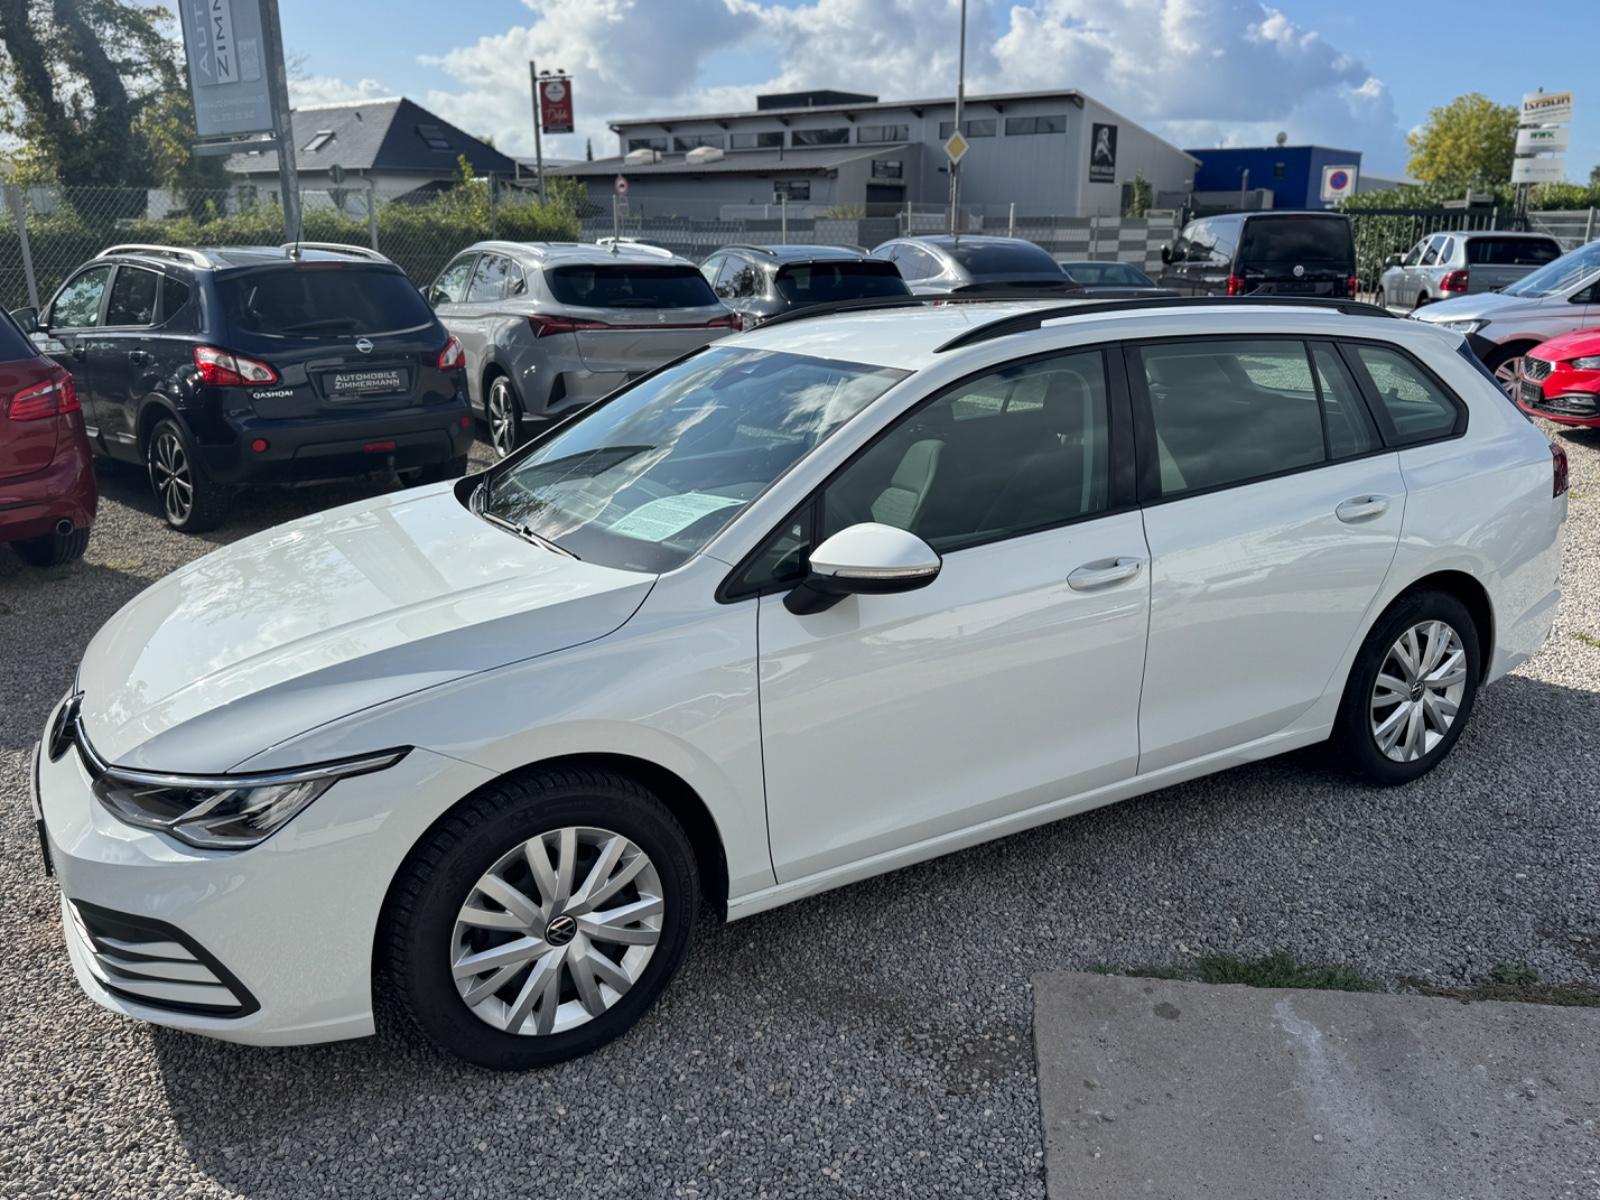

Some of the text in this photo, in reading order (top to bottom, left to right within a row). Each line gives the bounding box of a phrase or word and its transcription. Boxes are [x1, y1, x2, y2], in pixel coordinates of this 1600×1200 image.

[335, 371, 398, 382] AUTOMOBILE
[334, 378, 400, 389] ZIMMERMANN
[252, 390, 293, 399] QASHQAI
